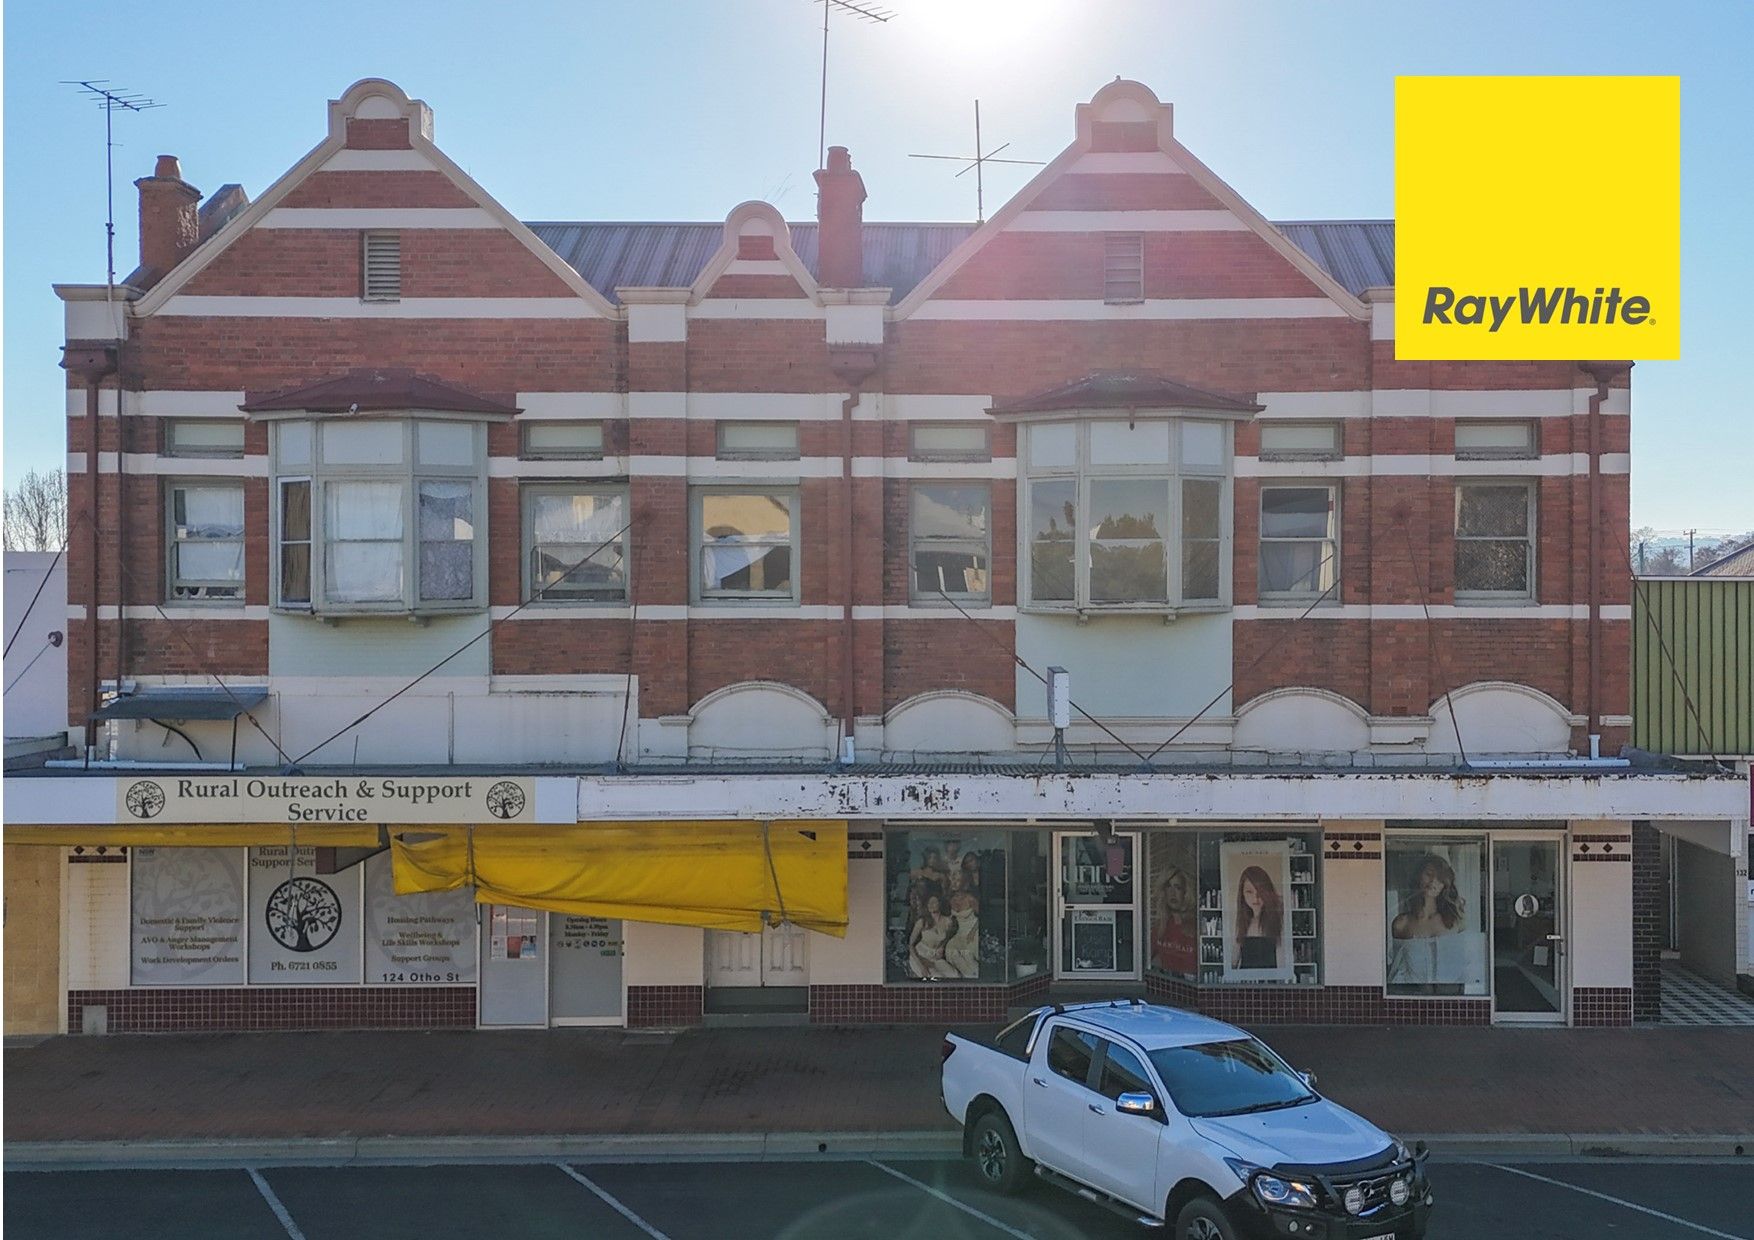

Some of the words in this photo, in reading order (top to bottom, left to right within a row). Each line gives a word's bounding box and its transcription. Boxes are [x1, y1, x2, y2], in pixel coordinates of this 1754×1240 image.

[177, 780, 237, 798] Rural
[247, 780, 346, 798] Outreach
[356, 781, 374, 798] &
[382, 780, 471, 803] Support
[288, 803, 366, 821] Service
[259, 847, 288, 856] Rural
[387, 916, 418, 925] Housing
[420, 916, 454, 925] Pathways
[174, 924, 205, 933] Support
[167, 936, 188, 945] Anger
[190, 936, 238, 945] Management
[419, 940, 460, 948] Workshops
[169, 944, 211, 952] Workshops
[163, 956, 211, 965] Development
[391, 955, 421, 964] Support
[423, 955, 450, 963] Groups
[271, 962, 286, 971] Ph.
[288, 962, 310, 971] 6721
[312, 962, 338, 971] 0855
[383, 973, 404, 982] 124
[410, 973, 441, 982] Otho
[447, 973, 460, 982] St
